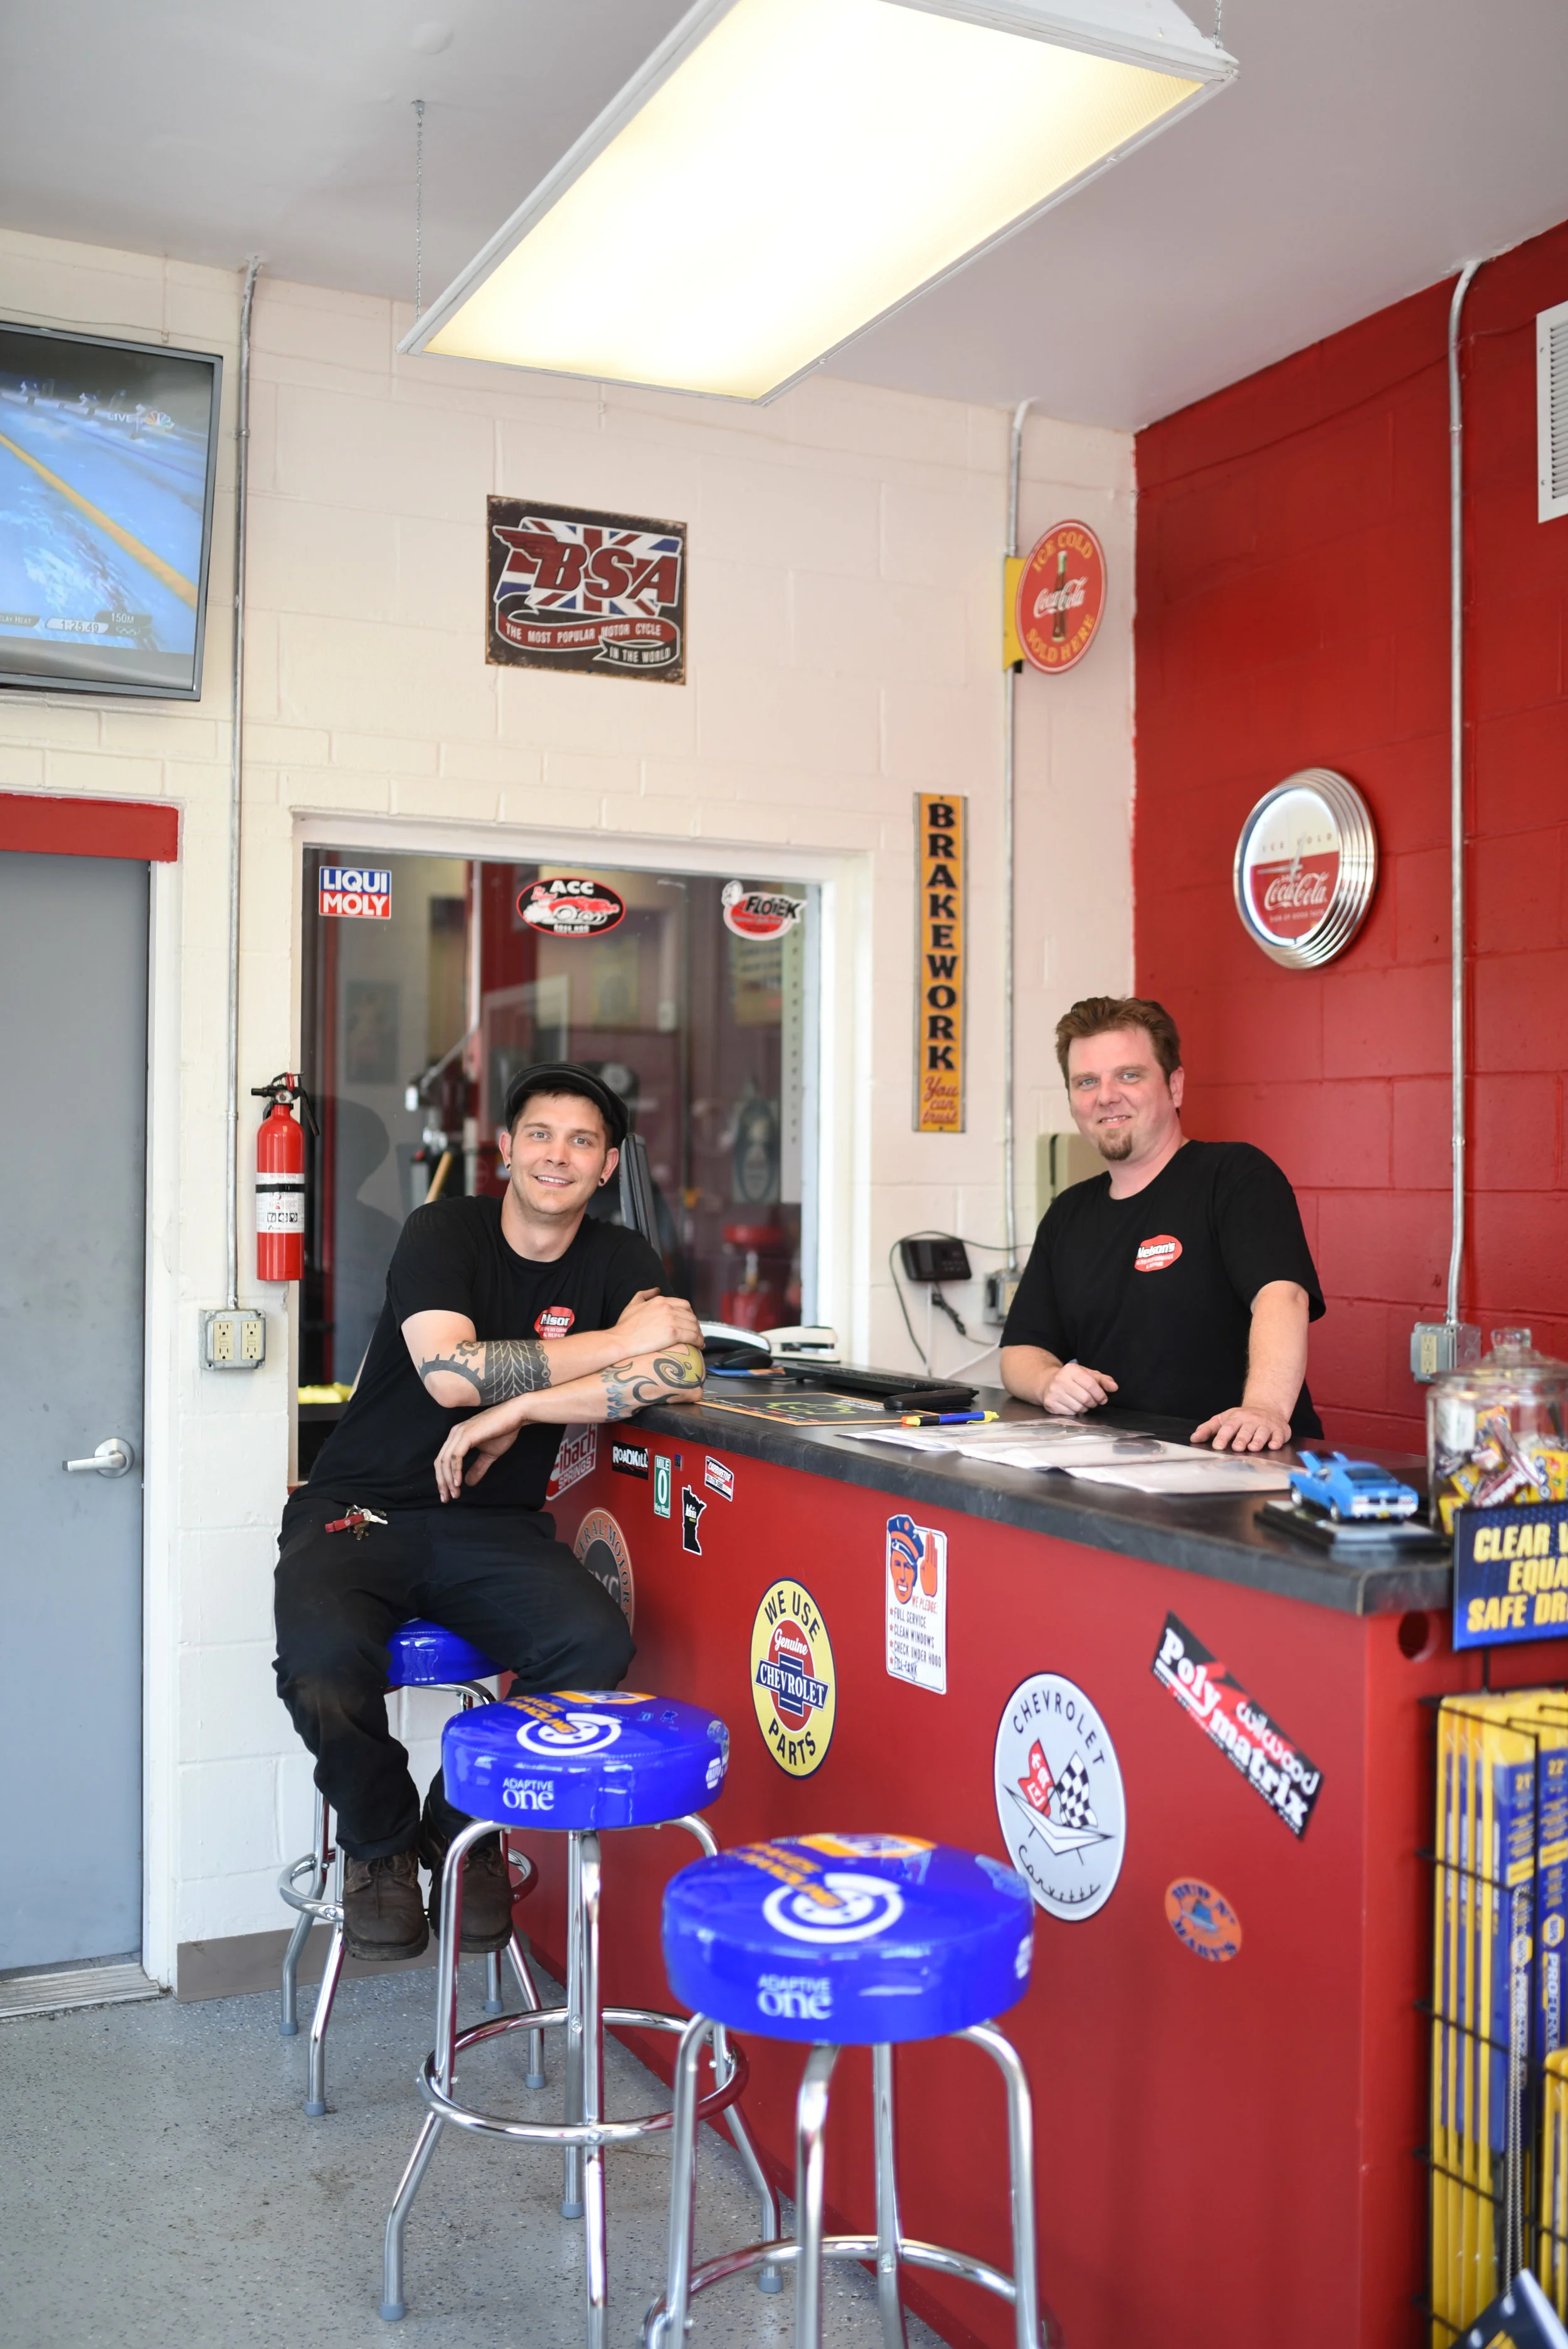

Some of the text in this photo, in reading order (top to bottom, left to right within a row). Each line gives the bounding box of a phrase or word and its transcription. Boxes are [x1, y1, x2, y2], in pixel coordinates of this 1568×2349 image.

[1032, 531, 1093, 572] ICE COLD
[534, 541, 679, 605] BSA
[506, 622, 661, 644] THE MOST POPULAR MOTOR CYCLE
[1027, 613, 1095, 662] SOLD HERE
[610, 645, 670, 663] IN THE WORLD
[323, 869, 388, 893] LIQUI
[549, 879, 595, 895] ACC
[323, 892, 388, 916] MOLY
[613, 1446, 649, 1468] ROADKILL
[656, 1457, 670, 1471] MILE
[558, 1456, 591, 1490] SPRINGS
[657, 1469, 668, 1505] 0
[1473, 1523, 1551, 1564] CLEAR
[764, 1589, 820, 1642] WE USE
[911, 1595, 919, 1608] WE
[1466, 1591, 1568, 1633] SAFE DR
[894, 1607, 926, 1629] FULL SERVICE
[774, 1628, 808, 1656] Genuine
[894, 1623, 935, 1649] CLEAN WINDOWS
[894, 1640, 941, 1668] CHECK UNDER HOOD
[760, 1662, 825, 1707] CHEVROLET
[768, 1717, 817, 1766] PARTS
[1013, 1690, 1105, 1766] CHEVROLET
[503, 1778, 554, 1791] ADAPTIVE
[503, 1788, 554, 1811] one
[1018, 1845, 1102, 1905] Corvette
[758, 1974, 831, 1993] ADAPTIVE
[757, 1990, 833, 2020] one
